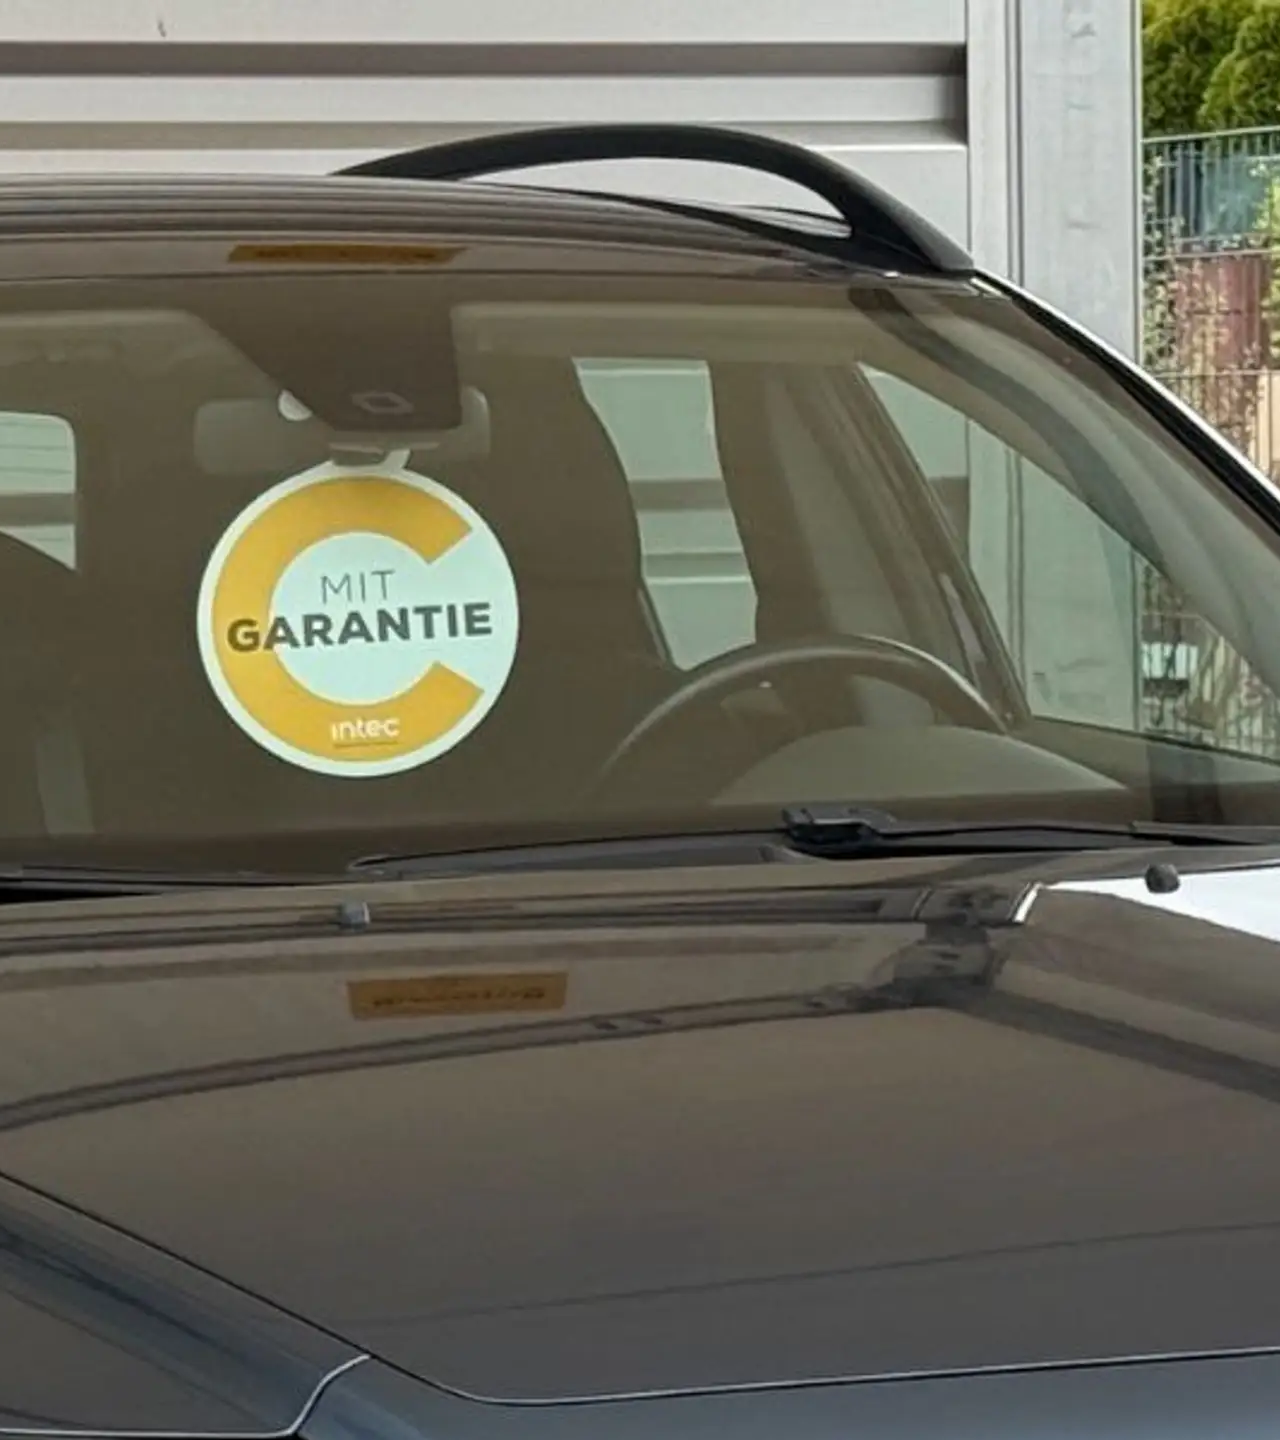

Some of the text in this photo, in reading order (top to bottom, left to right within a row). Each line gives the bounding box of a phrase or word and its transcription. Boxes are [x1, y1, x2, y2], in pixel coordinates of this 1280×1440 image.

[320, 568, 396, 605] MIT
[227, 603, 493, 653] GARANTIE
[330, 715, 401, 743] intec
